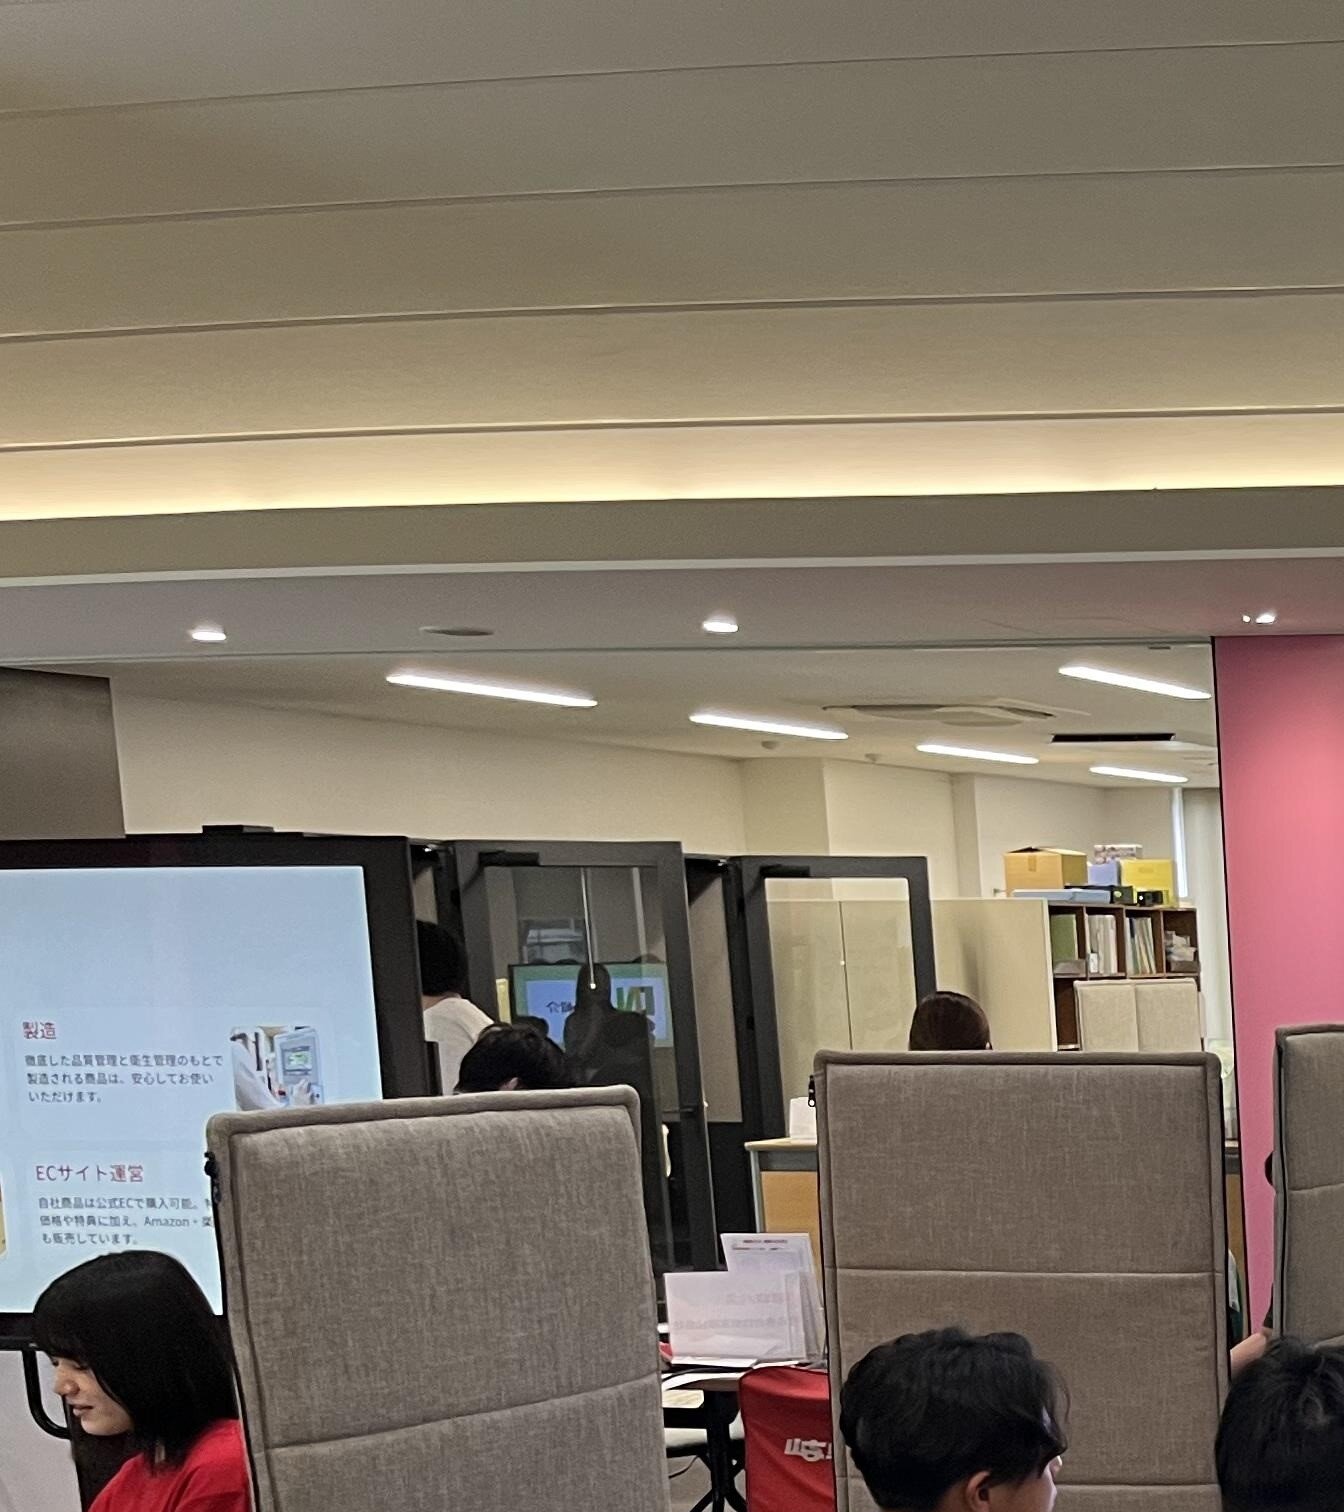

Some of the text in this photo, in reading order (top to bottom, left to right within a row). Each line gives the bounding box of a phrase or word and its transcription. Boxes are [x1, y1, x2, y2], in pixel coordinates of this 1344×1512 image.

[22, 1021, 57, 1040] 製造
[35, 1165, 144, 1183] ECサイト運営
